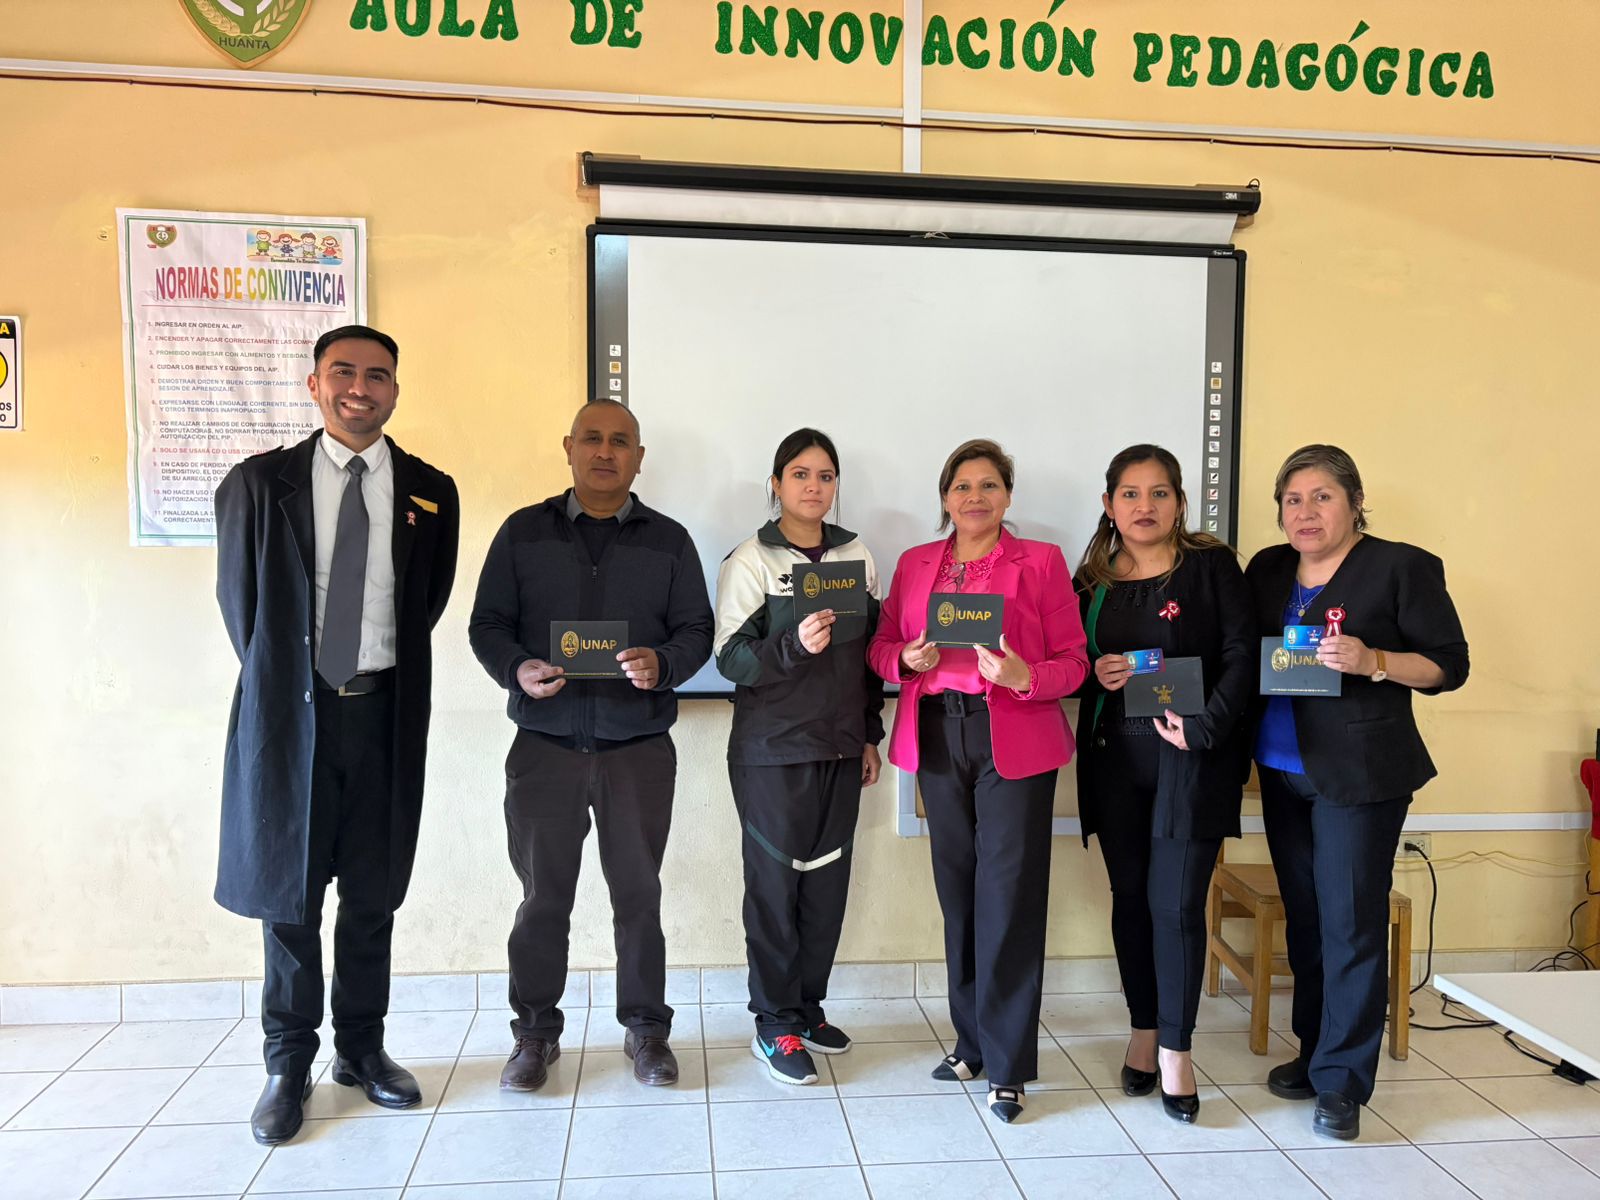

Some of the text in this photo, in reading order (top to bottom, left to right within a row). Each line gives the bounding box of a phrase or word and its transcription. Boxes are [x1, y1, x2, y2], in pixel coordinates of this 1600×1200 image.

[218, 36, 271, 51] HUANTA
[350, 0, 519, 41] AULA
[570, 0, 643, 48] DE
[1132, 20, 1495, 98] PEDAGÓGICA
[1225, 192, 1238, 200] 3M
[156, 266, 346, 307] NORMAS DE CONVIVENCIA
[823, 578, 856, 590] UNAP
[958, 610, 992, 621] UNAP
[582, 639, 618, 650] UNAP
[1294, 655, 1326, 666] UNA
